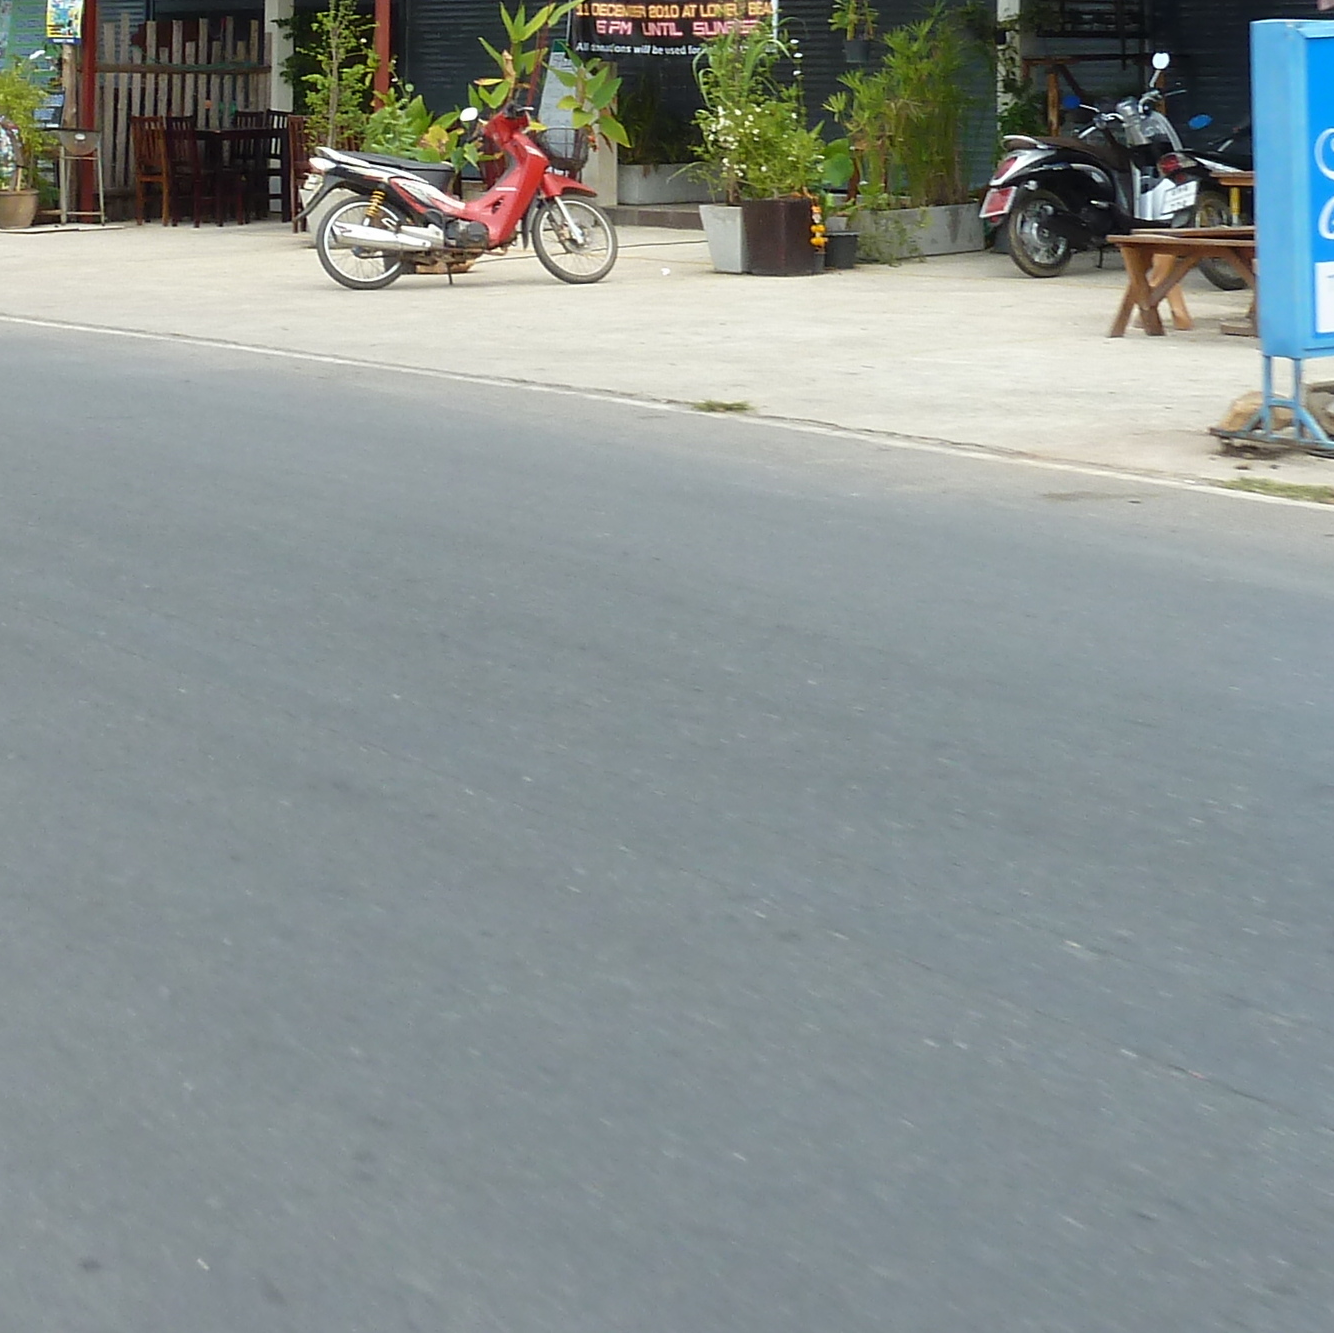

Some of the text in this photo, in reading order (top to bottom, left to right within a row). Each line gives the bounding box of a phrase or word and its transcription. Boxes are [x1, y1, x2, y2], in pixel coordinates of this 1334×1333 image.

[591, 3, 647, 18] DECEMBER
[648, 4, 680, 18] 2010
[681, 4, 698, 17] AT
[699, 2, 743, 18] LONEL
[642, 22, 683, 36] UNTIL
[576, 42, 589, 51] All
[651, 44, 664, 55] be
